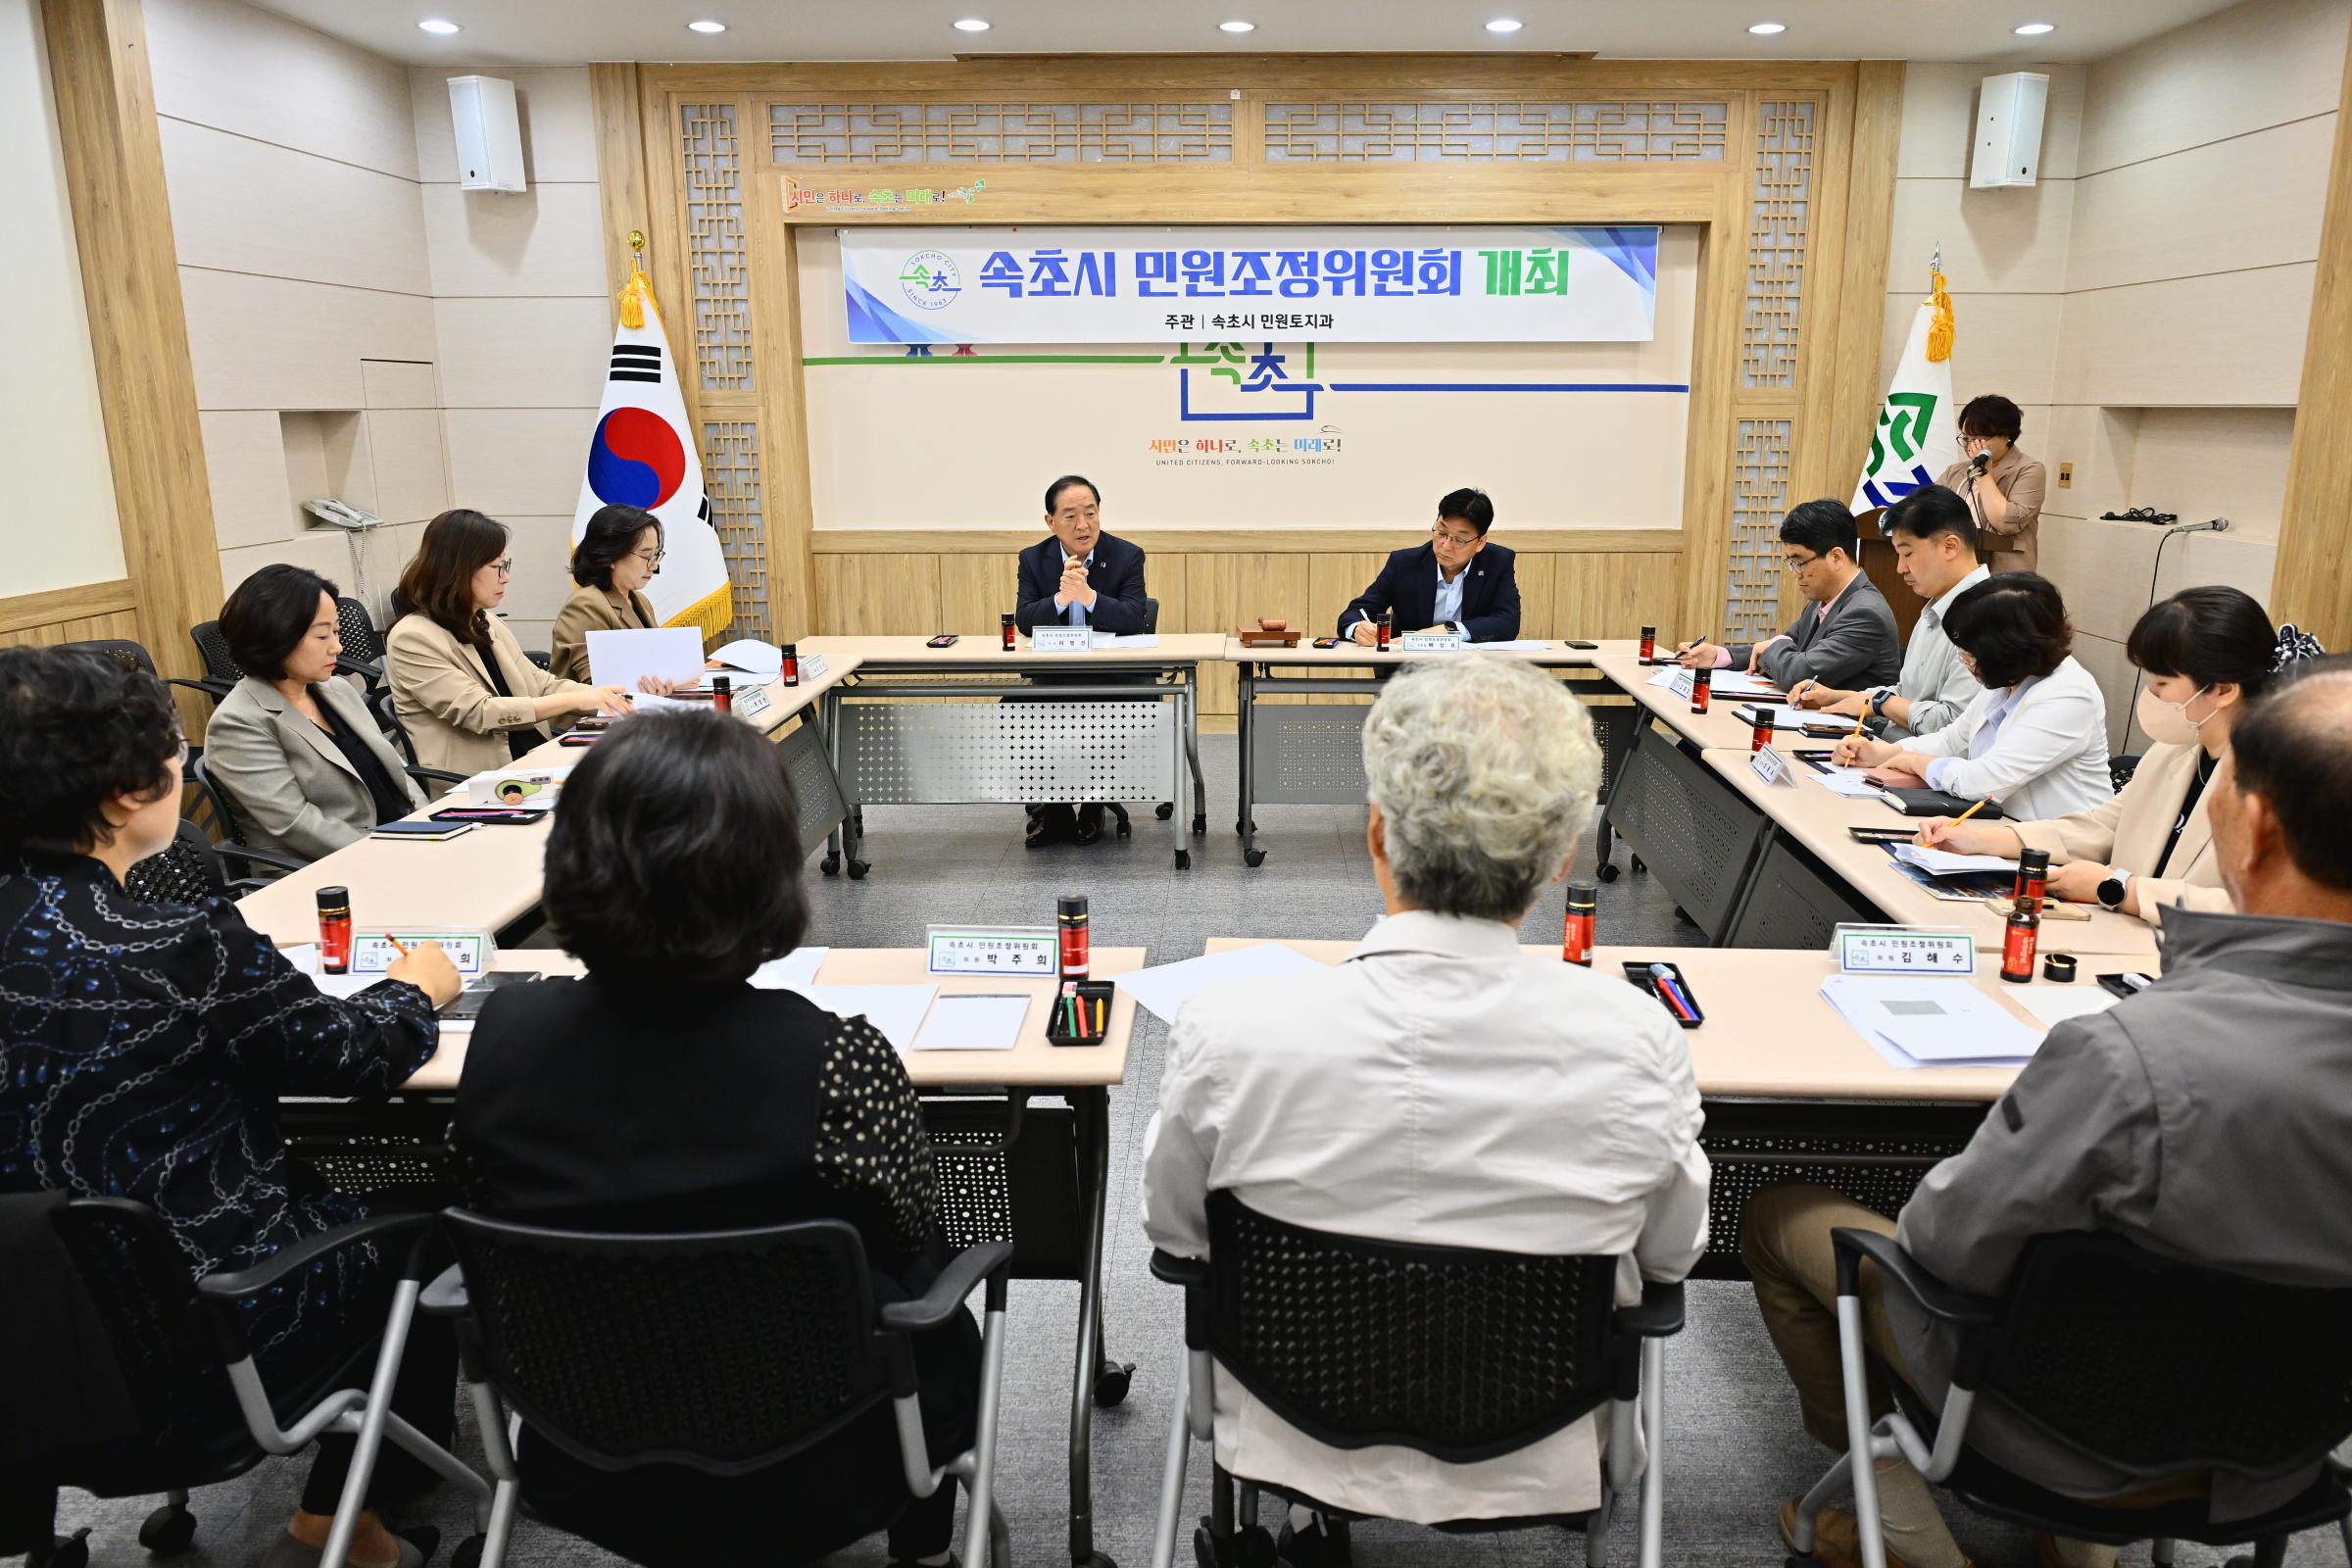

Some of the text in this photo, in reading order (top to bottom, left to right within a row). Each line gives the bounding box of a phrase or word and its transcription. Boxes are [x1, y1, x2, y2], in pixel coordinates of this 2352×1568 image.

[791, 189, 946, 204] 시민은 하나로, 속초는 미래로!
[911, 254, 957, 277] SOKCHO CITY
[980, 247, 1570, 298] 속초시 민원조정위원회 개최
[907, 288, 947, 307] SINCE 1963
[1164, 314, 1334, 329] 주관 속초시 민원토지과
[1149, 438, 1341, 454] 시민은 하나로, 속초는 미래로!
[1891, 940, 1953, 949] 민원조정위원회
